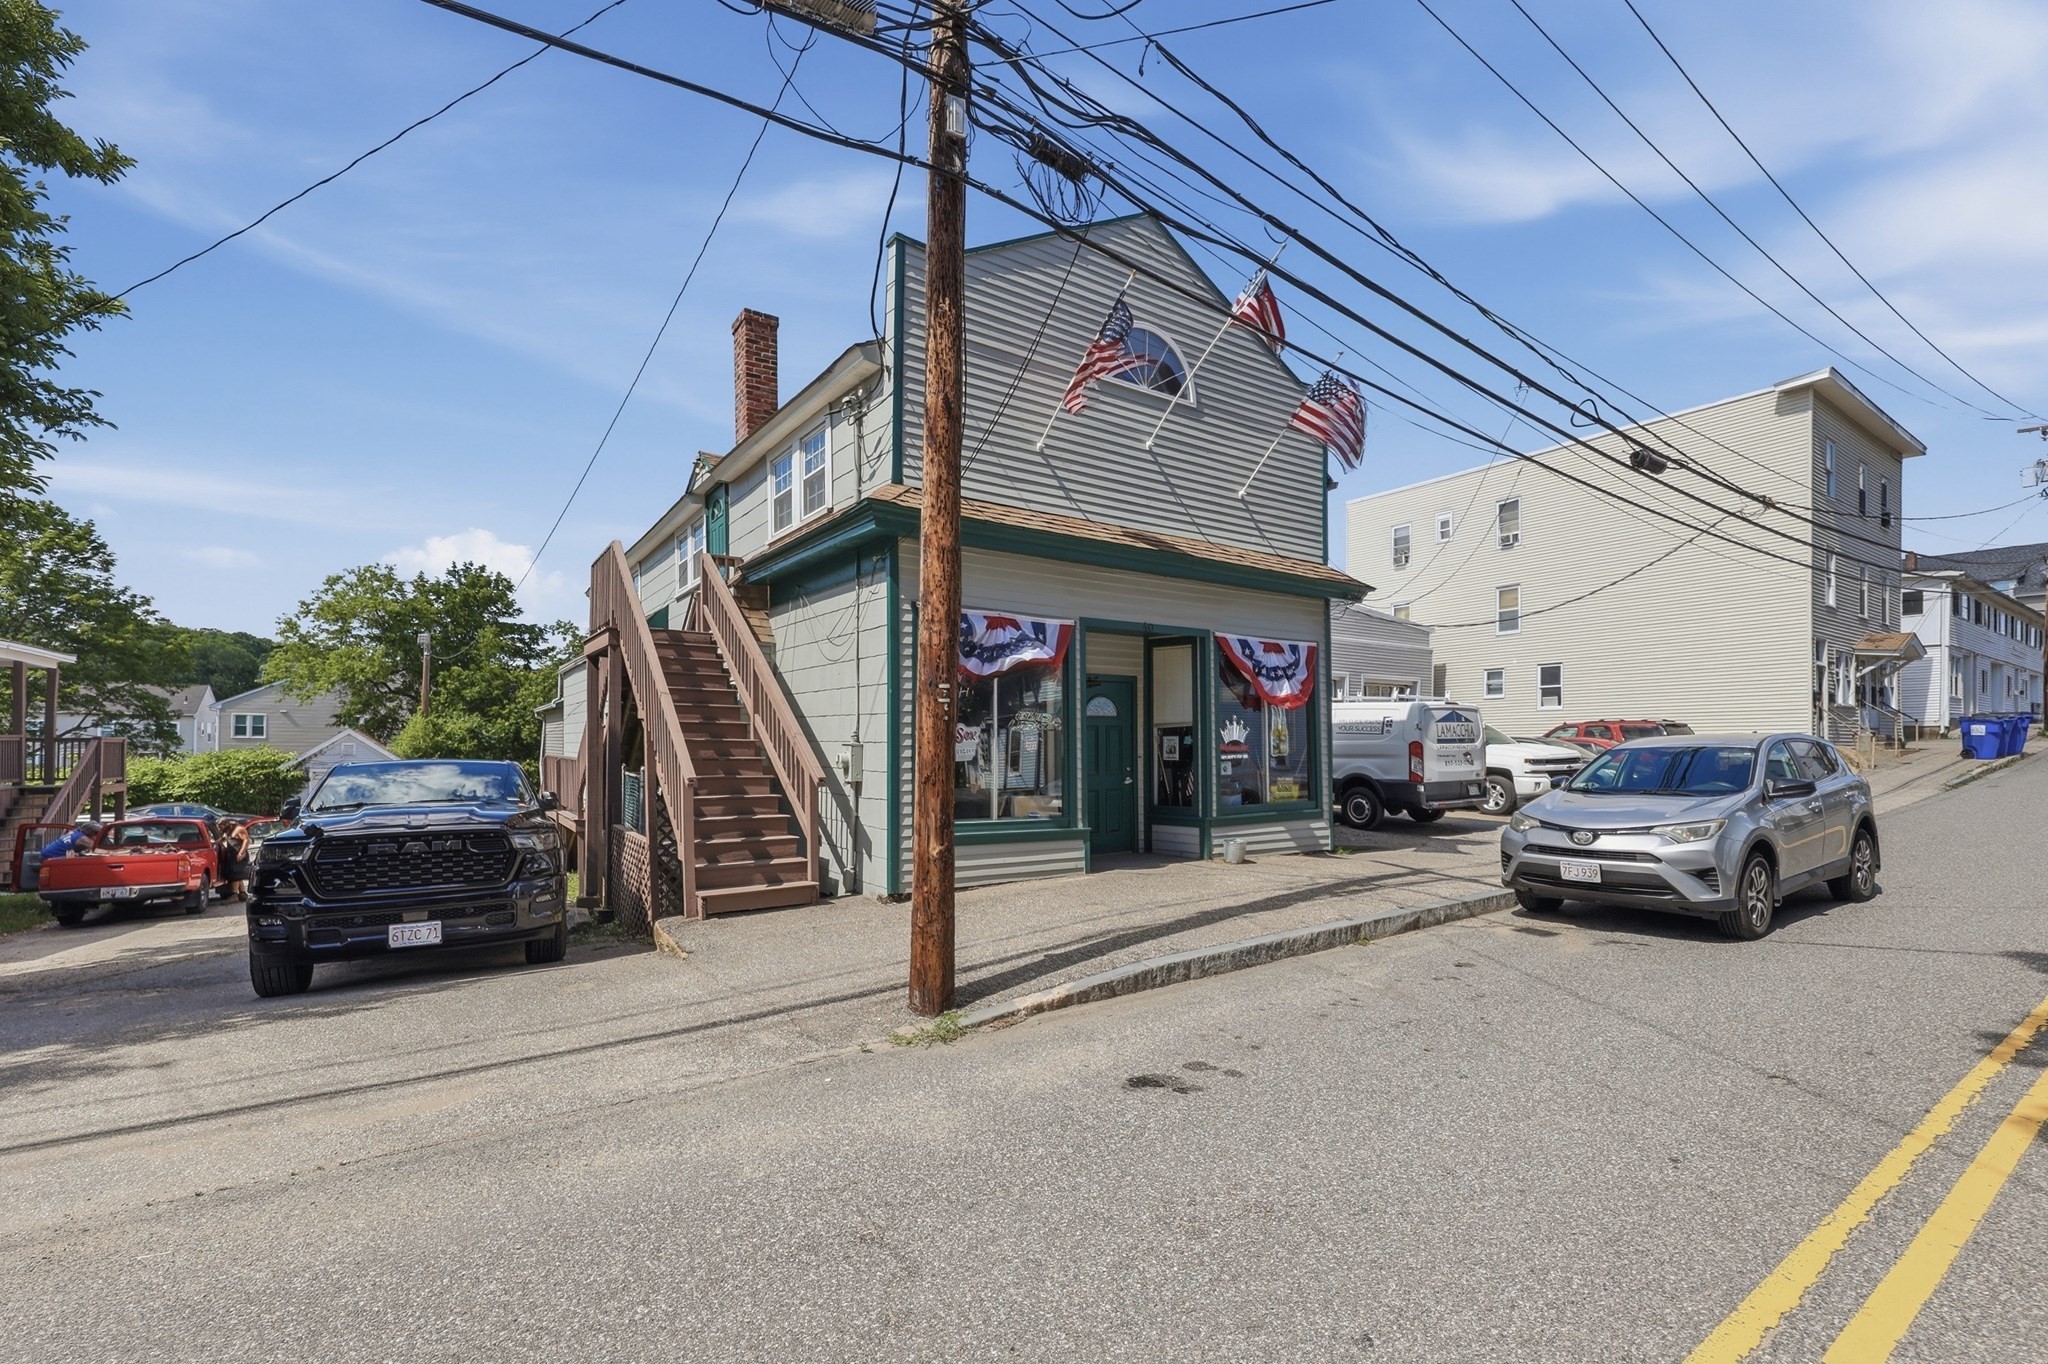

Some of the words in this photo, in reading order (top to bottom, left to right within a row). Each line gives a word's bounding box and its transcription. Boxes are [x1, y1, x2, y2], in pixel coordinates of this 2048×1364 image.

[1355, 725, 1381, 733] SUCCESS
[1436, 723, 1475, 738] LAMACCHIA
[368, 840, 462, 855] RAM
[1562, 865, 1579, 877] 7FJ
[1581, 867, 1598, 879] 939
[391, 929, 421, 942] 6TZC
[426, 927, 440, 940] 71
